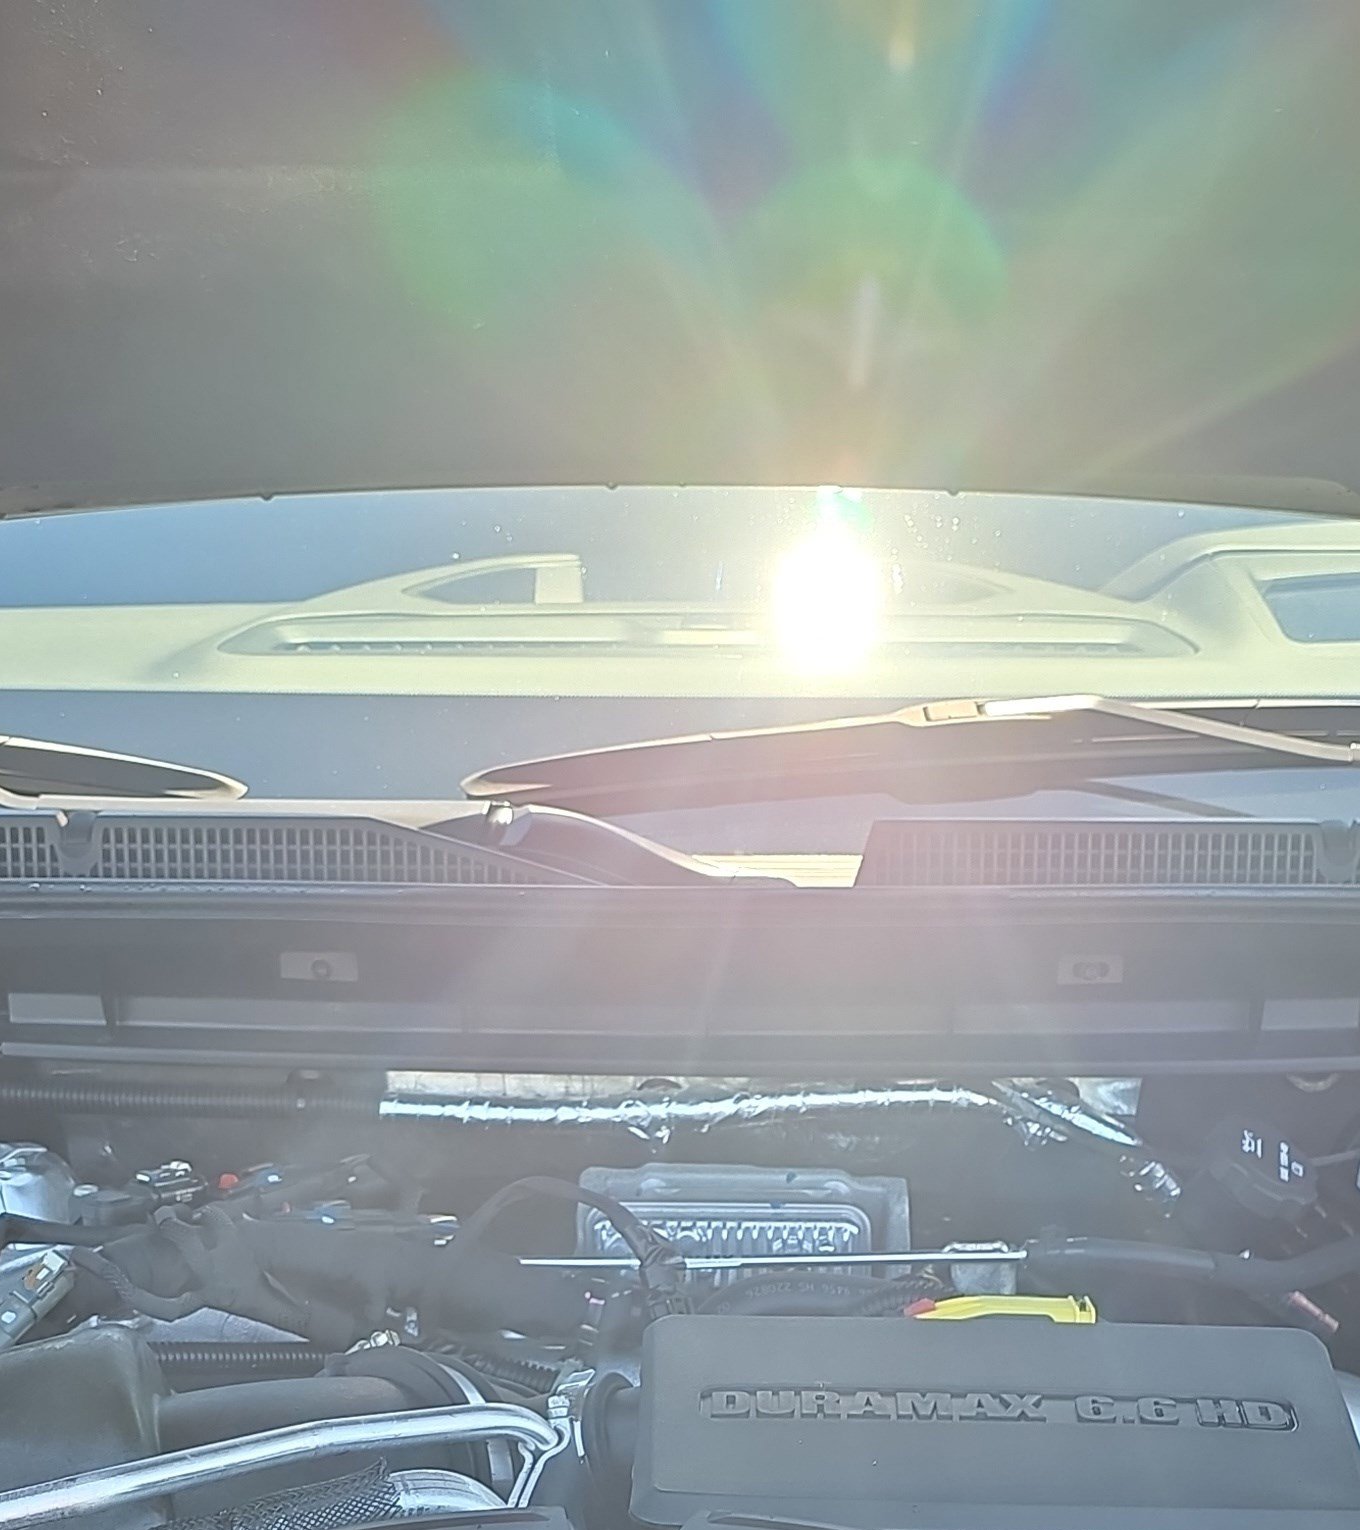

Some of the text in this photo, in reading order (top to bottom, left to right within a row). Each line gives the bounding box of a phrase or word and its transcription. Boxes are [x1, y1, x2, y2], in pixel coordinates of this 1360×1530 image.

[710, 1391, 1298, 1430] DURAMAX 6.6 HD
